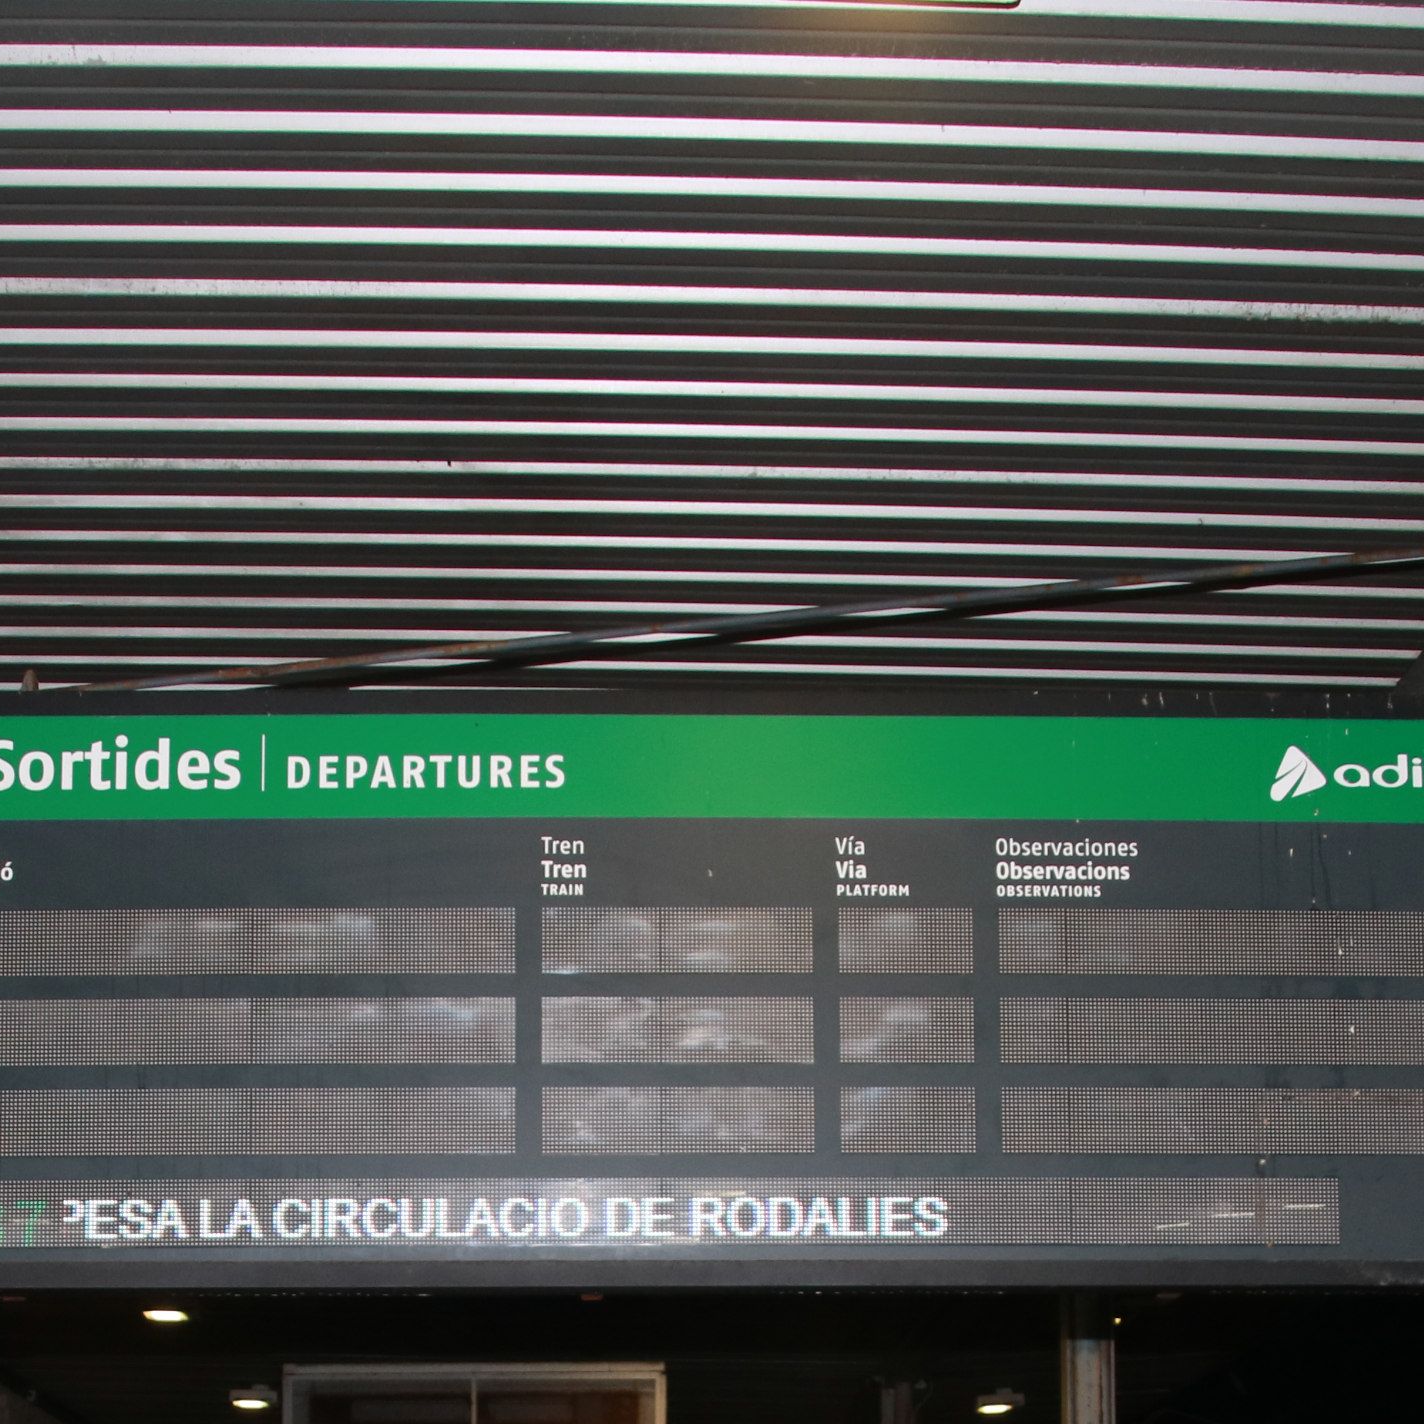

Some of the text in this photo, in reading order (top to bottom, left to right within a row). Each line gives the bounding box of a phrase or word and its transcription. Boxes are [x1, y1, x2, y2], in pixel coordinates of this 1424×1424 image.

[288, 754, 565, 788] DEPARTURES
[541, 836, 584, 854] Tren
[835, 836, 865, 855] Vía
[996, 838, 1138, 856] Observaciones
[541, 860, 587, 878] Tren
[835, 860, 867, 879] Via
[996, 861, 1130, 880] Observacions
[541, 884, 583, 896] TRAIN
[837, 884, 909, 896] PLATFORM
[996, 885, 1101, 897] OBSERVATIONS
[199, 1199, 263, 1238] LA
[272, 1198, 590, 1238] CIRCULACIO
[605, 1198, 675, 1237] DE
[689, 1197, 949, 1238] RODALIES
